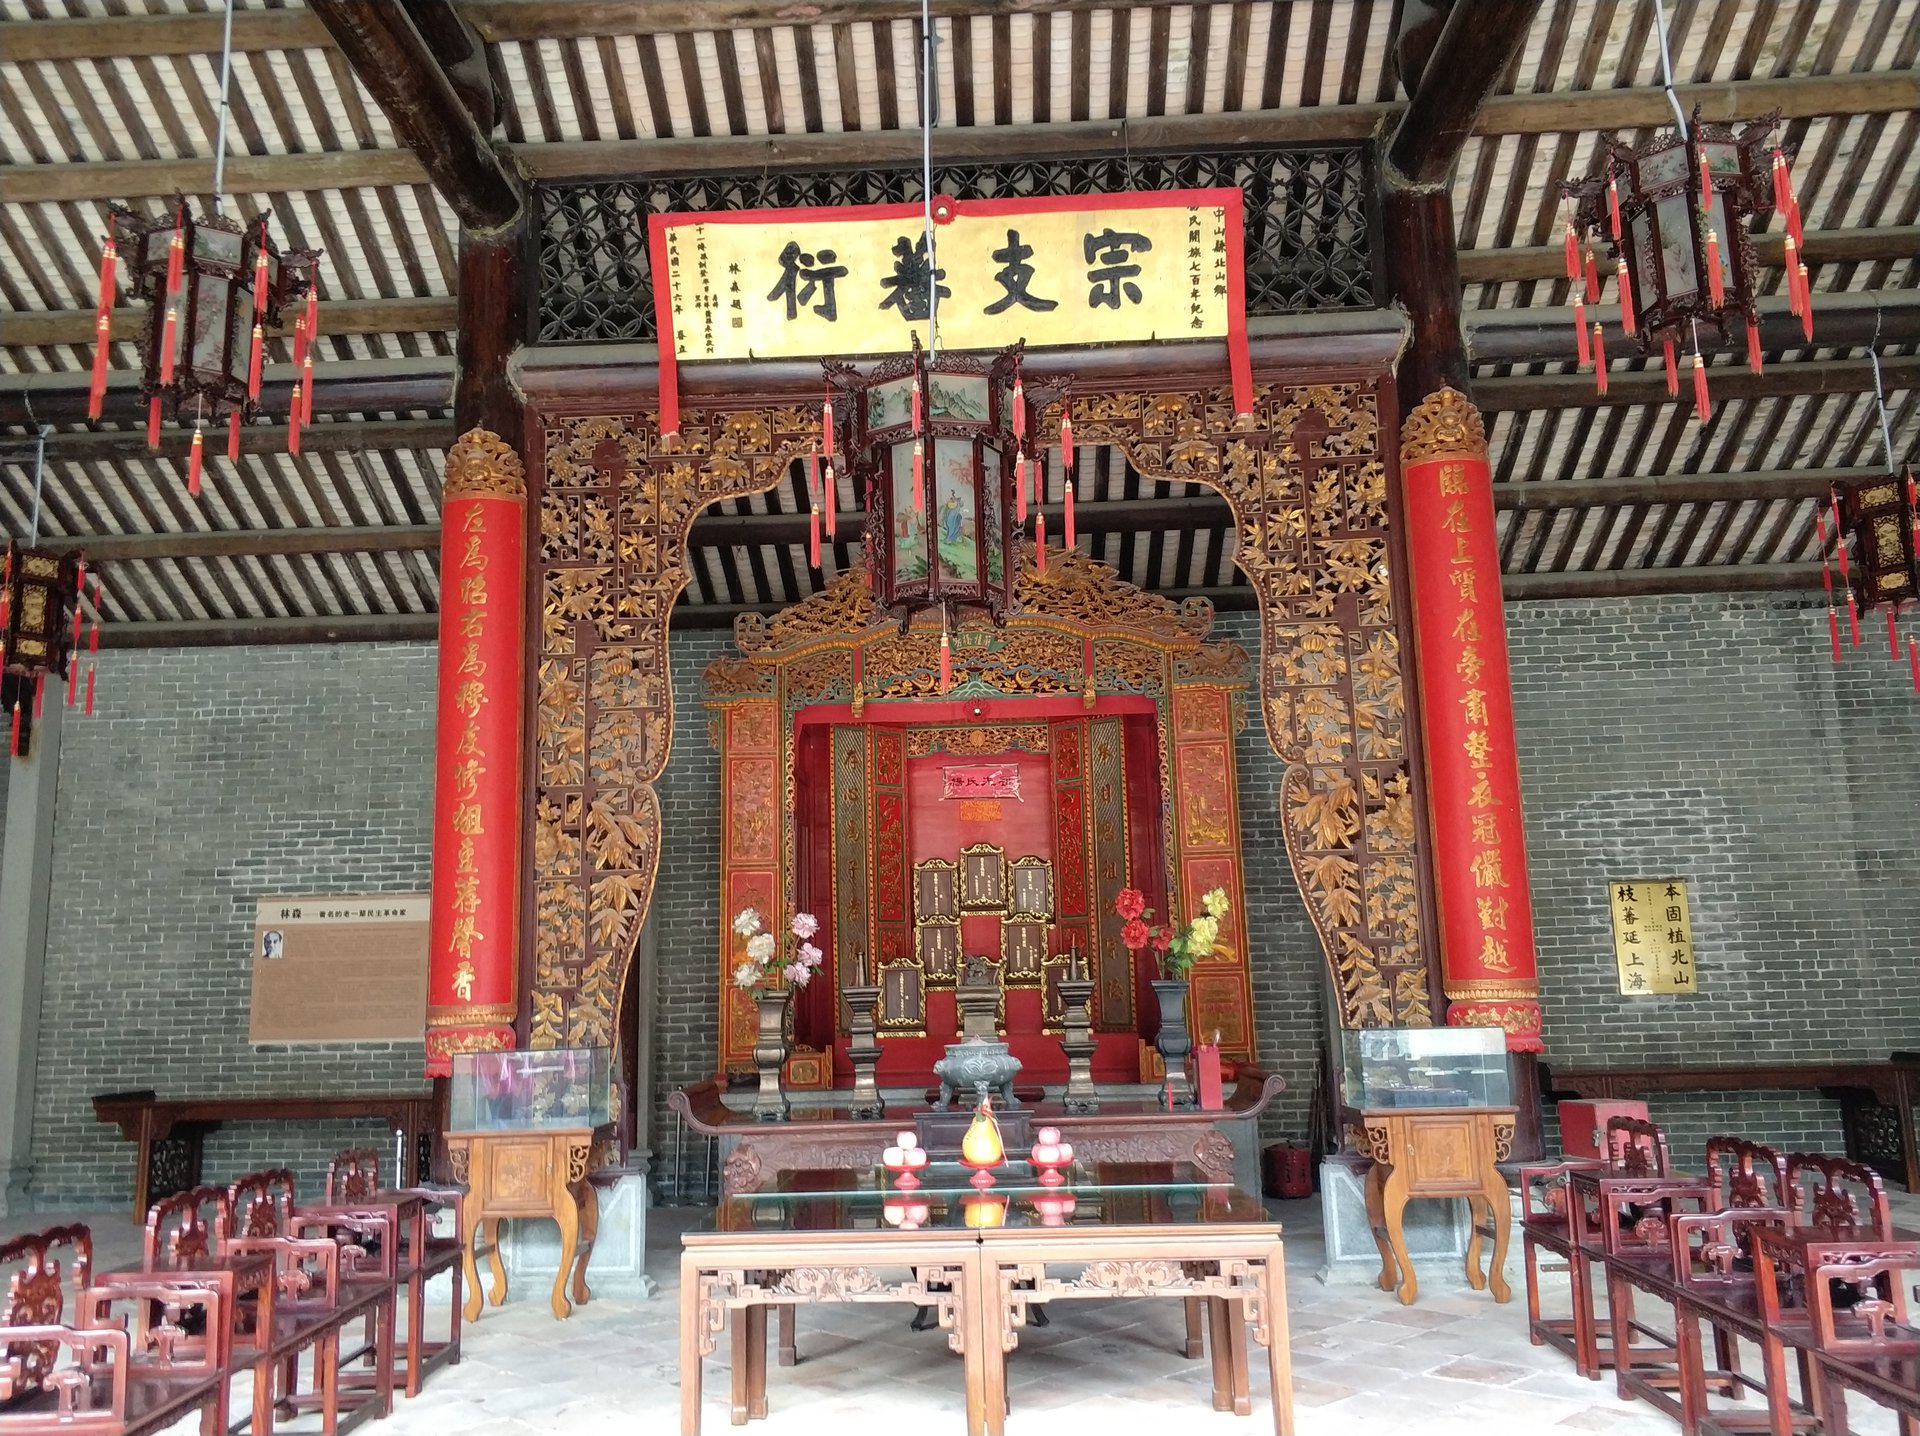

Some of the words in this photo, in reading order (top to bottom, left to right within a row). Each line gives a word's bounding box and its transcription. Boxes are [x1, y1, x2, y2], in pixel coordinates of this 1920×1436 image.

[1617, 884, 1647, 990] 枝蕃延上海
[1664, 883, 1690, 985] 本固植北山
